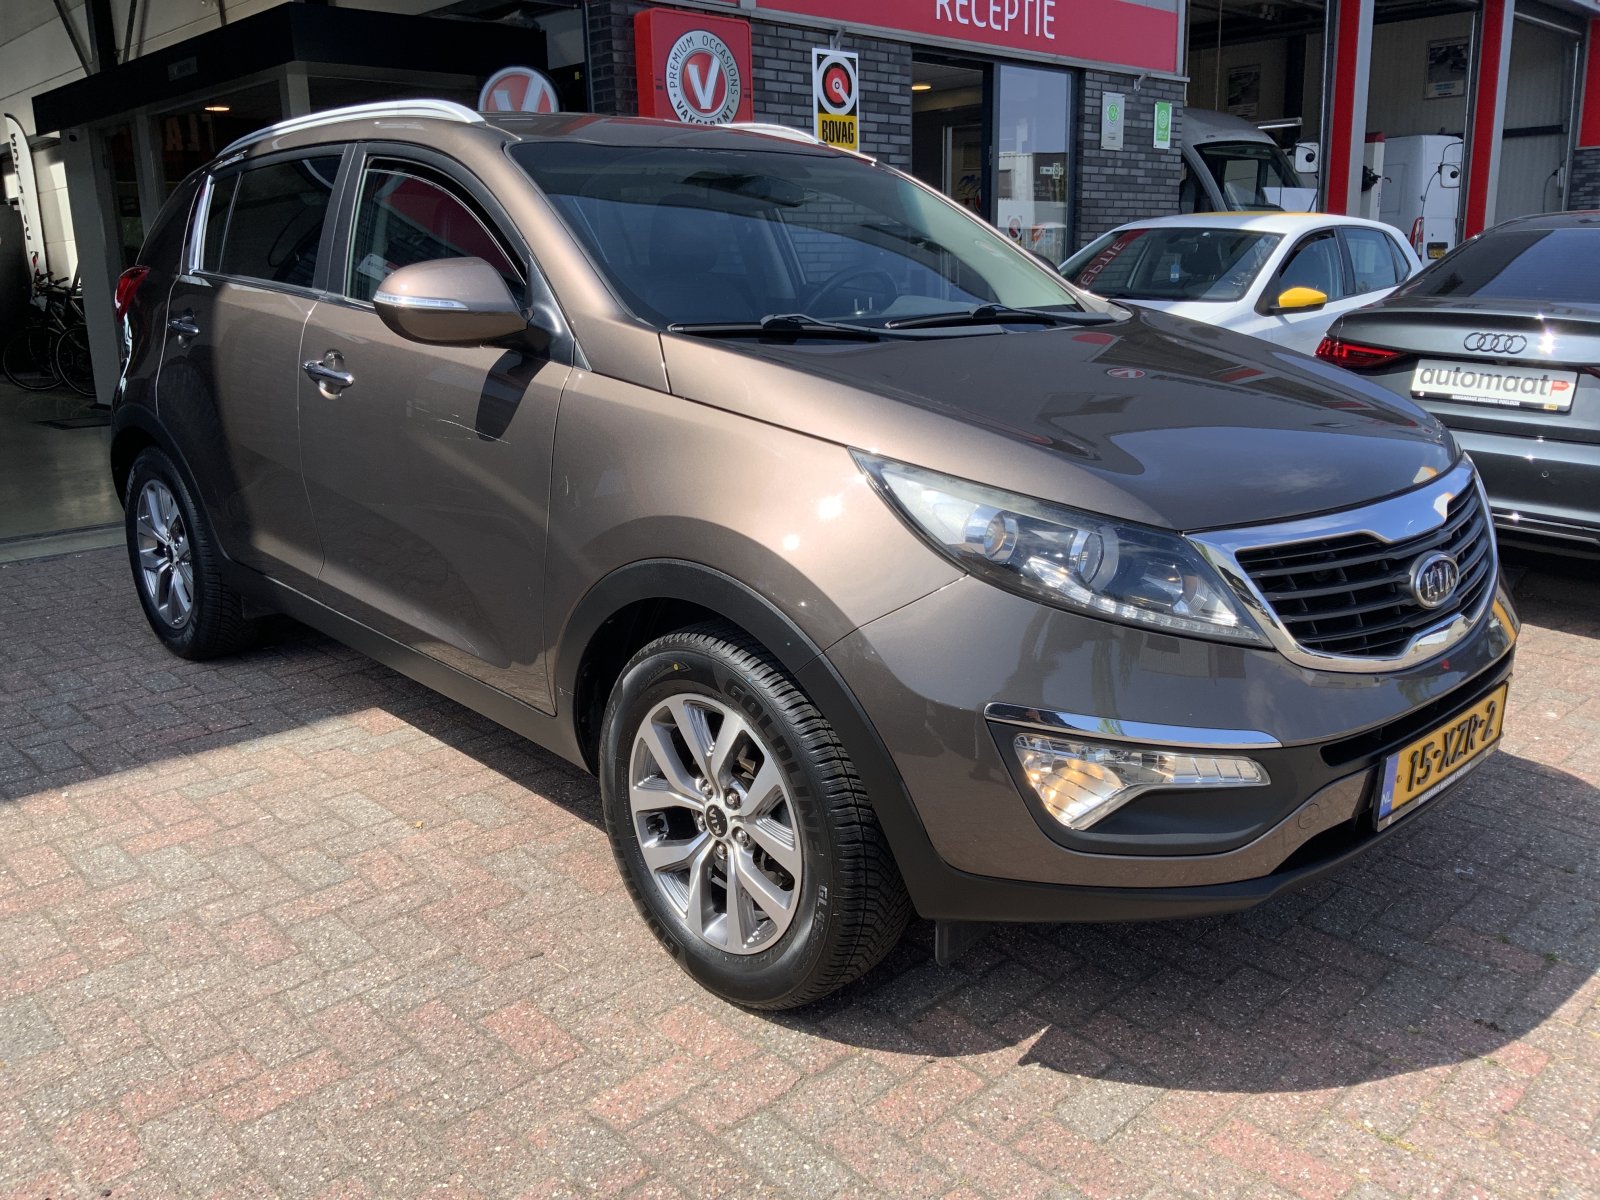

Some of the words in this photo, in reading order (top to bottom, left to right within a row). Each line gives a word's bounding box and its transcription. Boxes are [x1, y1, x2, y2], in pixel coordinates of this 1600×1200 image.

[936, 0, 1056, 40] RECEPTIE
[669, 34, 695, 89] PREMIUM
[701, 34, 739, 96] OCCASIONS
[821, 119, 855, 144] BOVAG
[1407, 701, 1497, 793] 15-XZR-2
[1380, 791, 1392, 807] NL
[708, 808, 724, 835] KIA
